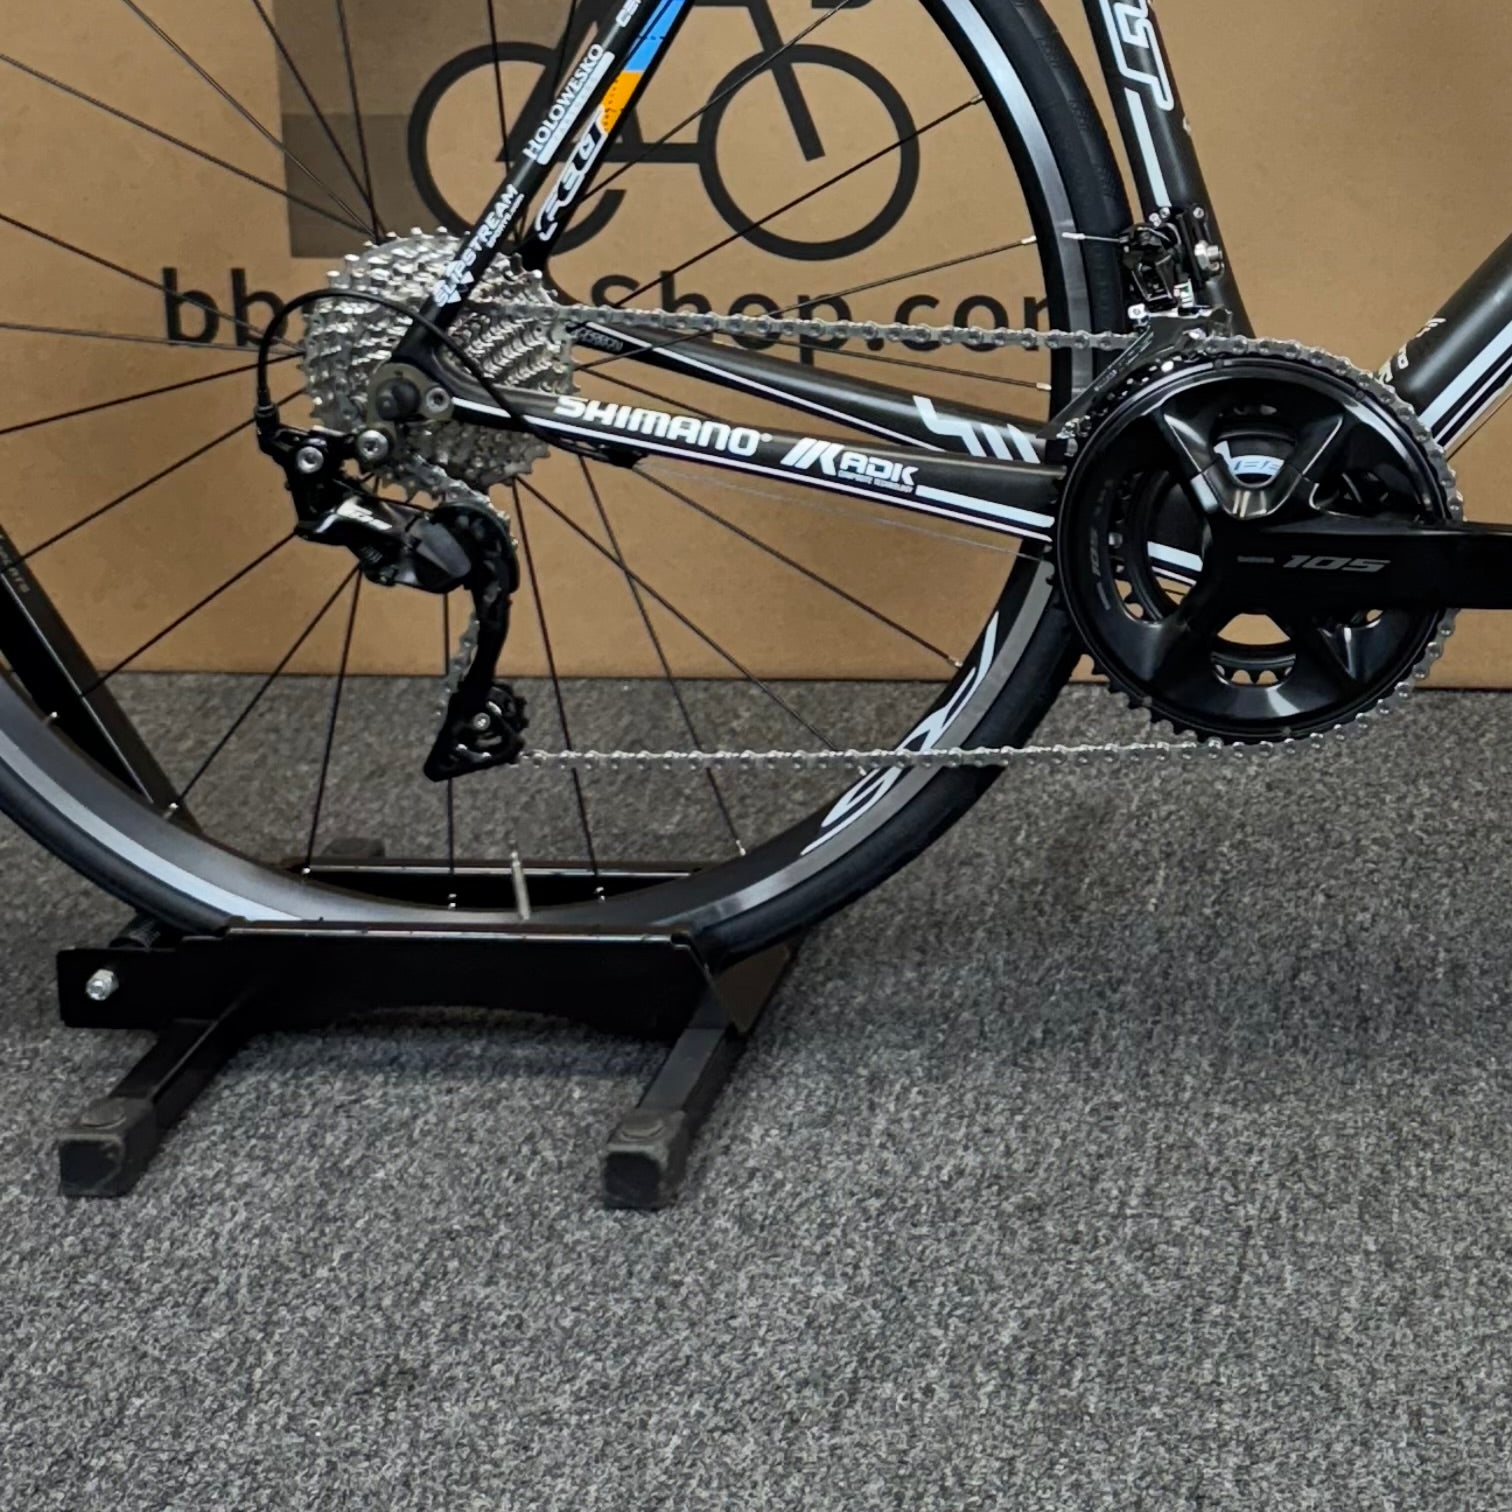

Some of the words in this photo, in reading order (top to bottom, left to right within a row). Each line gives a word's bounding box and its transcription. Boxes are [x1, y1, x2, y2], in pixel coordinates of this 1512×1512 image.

[522, 42, 603, 162] HOLOWESKO
[433, 183, 519, 307] SLIPSTREAM
[553, 397, 761, 457] SHIMANO
[840, 453, 918, 486] ADK
[1283, 554, 1391, 573] 105
